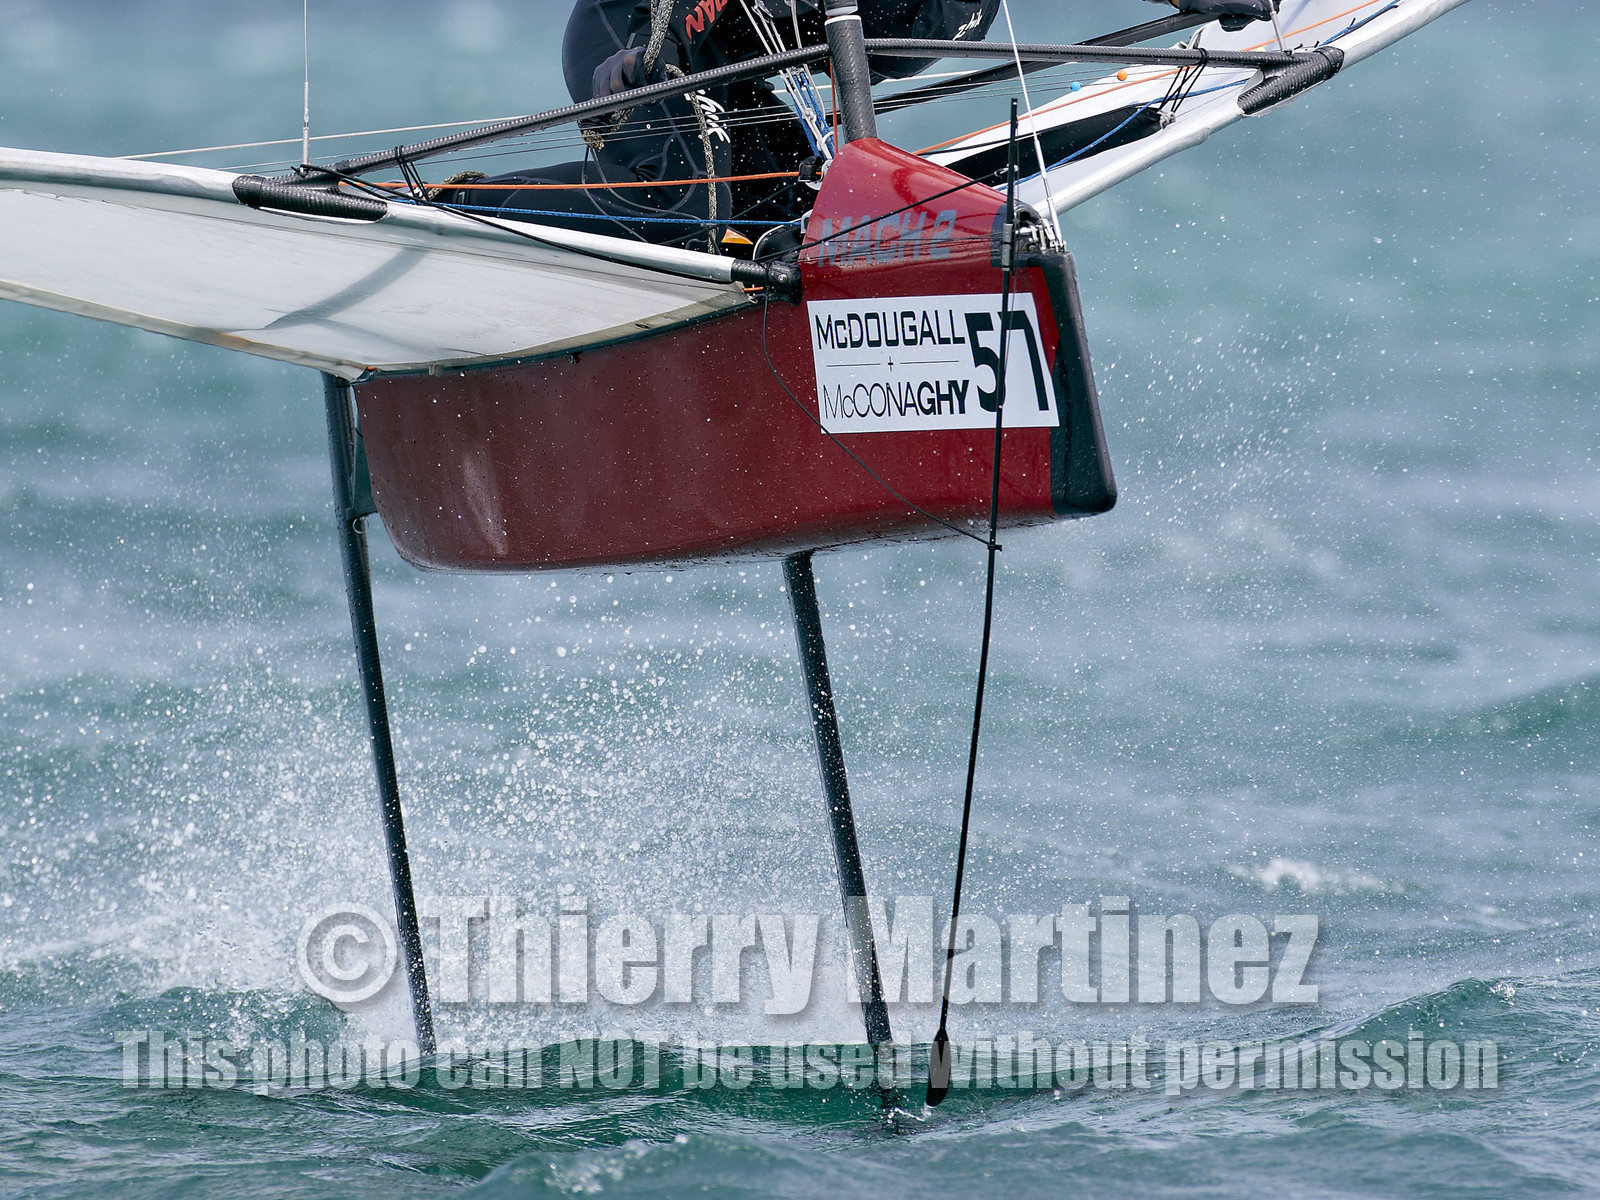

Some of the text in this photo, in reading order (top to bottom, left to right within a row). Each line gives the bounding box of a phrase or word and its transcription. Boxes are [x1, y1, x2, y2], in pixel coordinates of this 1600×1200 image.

[815, 309, 965, 350] McDOUGALL
[964, 310, 1050, 413] 57
[822, 379, 970, 419] McCONAGHY
